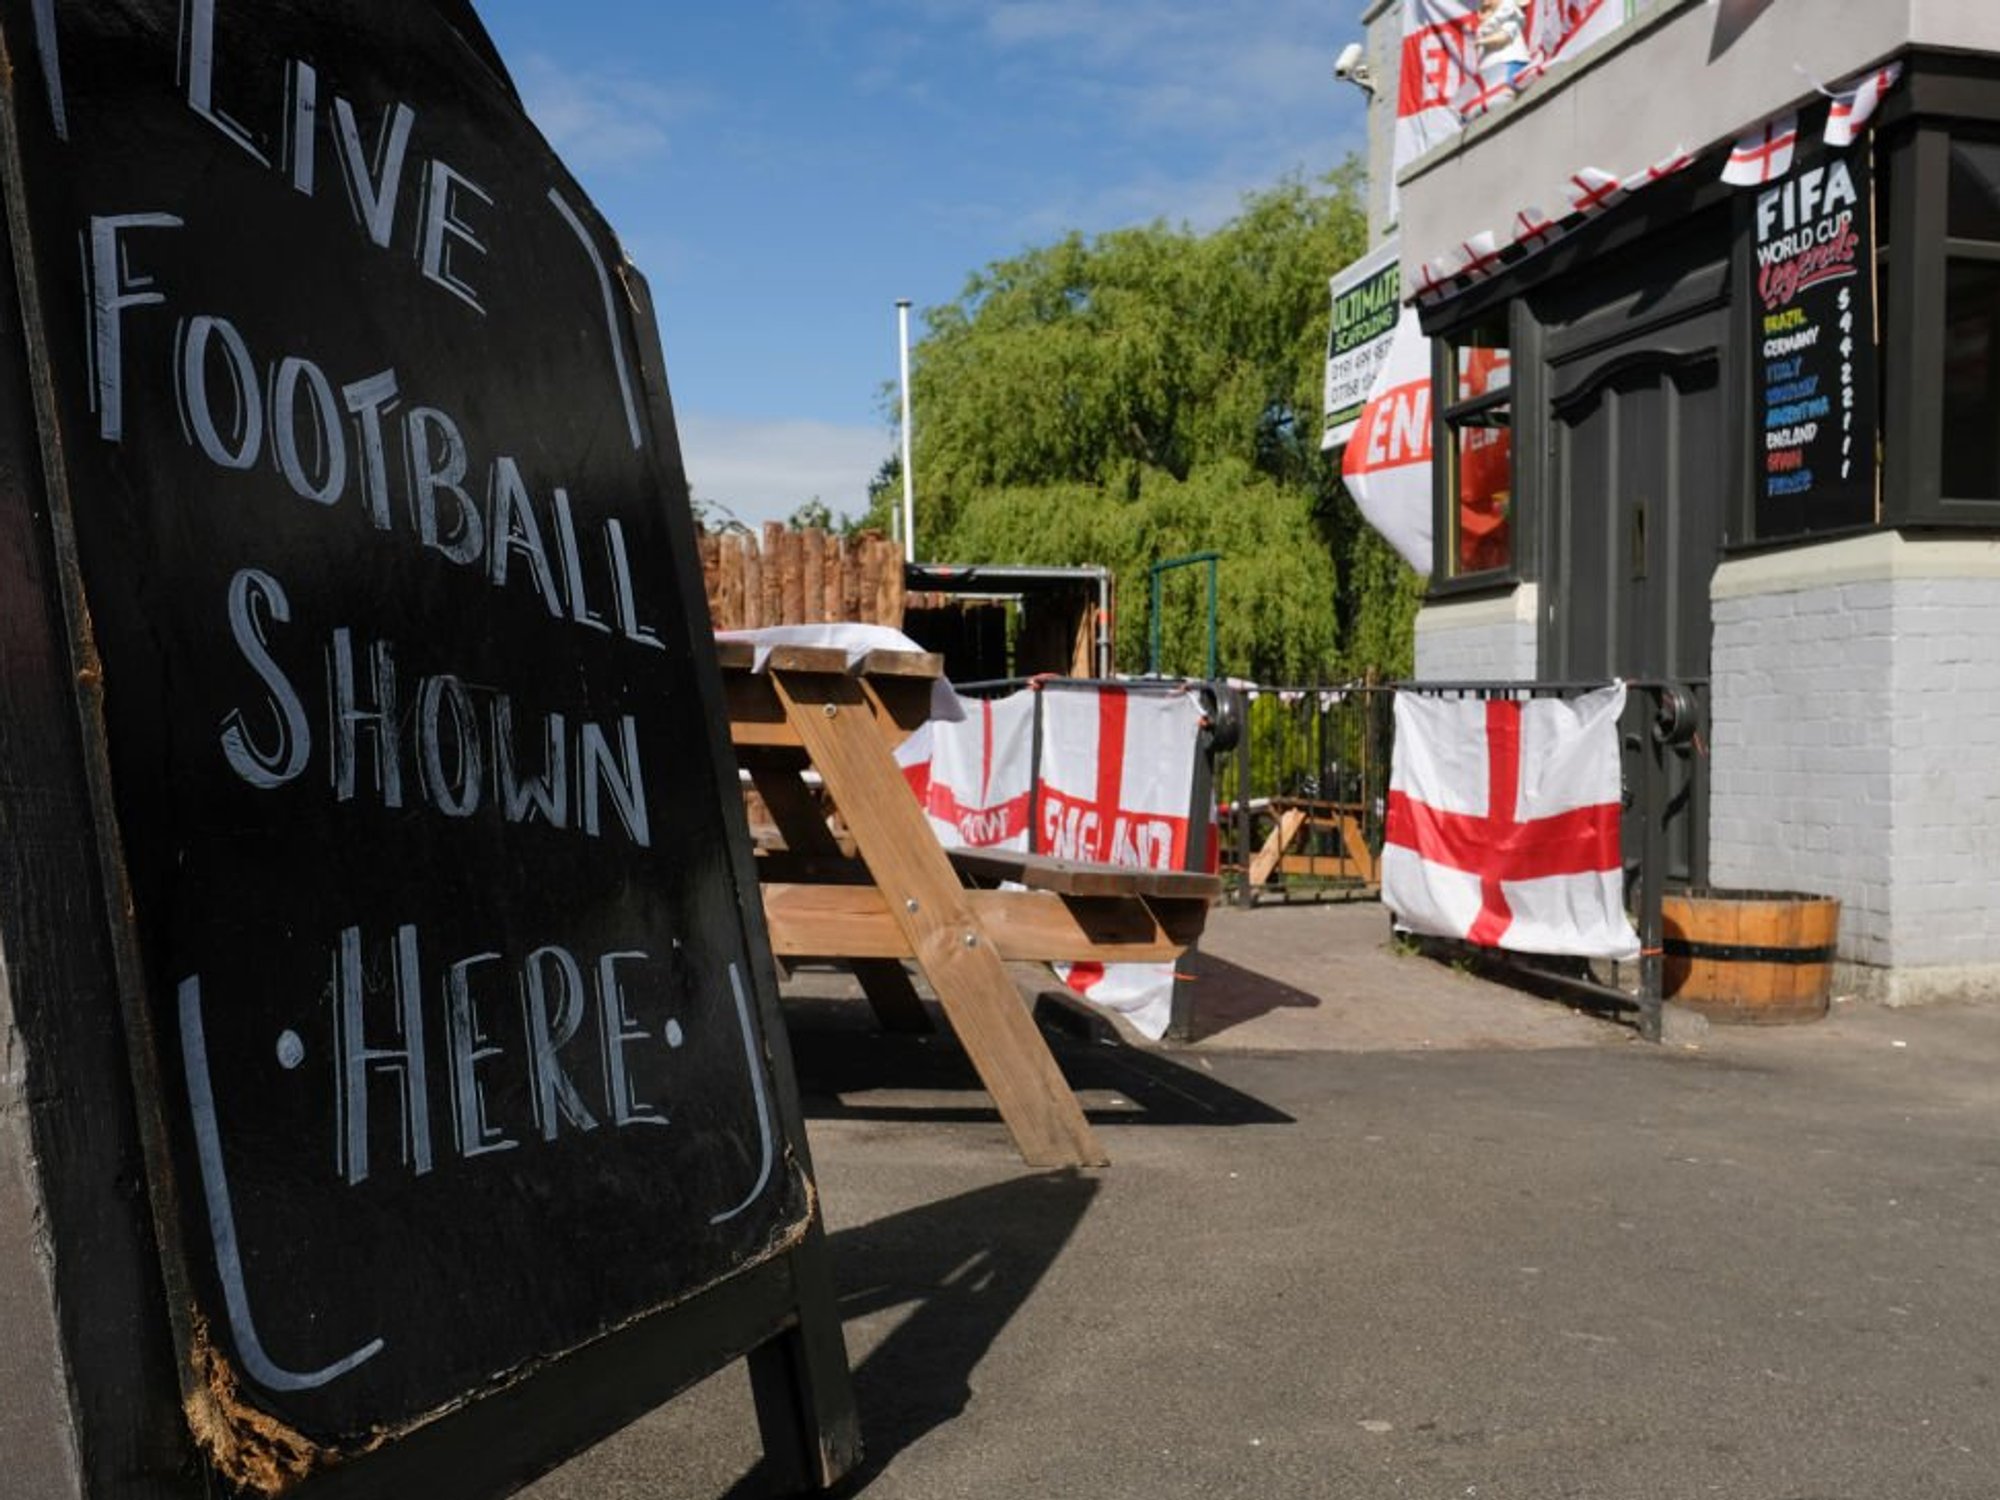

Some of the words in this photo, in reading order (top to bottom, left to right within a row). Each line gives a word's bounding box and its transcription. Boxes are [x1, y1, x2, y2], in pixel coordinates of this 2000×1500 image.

[176, 0, 494, 317] LIVE
[1757, 160, 1857, 242] FIFA
[1757, 229, 1814, 268] WORLD
[1816, 210, 1853, 242] CUP
[1333, 266, 1400, 332] ULTIMATE
[1763, 325, 1820, 358] GERMANY
[1839, 336, 1853, 359] 4
[1841, 361, 1853, 385] 2
[1366, 386, 1432, 464] EN
[1842, 385, 1854, 408] 2
[79, 212, 667, 650] FOOTBALL
[1765, 421, 1818, 450] ENGLAND
[220, 568, 651, 848] SHOWN
[331, 923, 670, 1187] HERE
